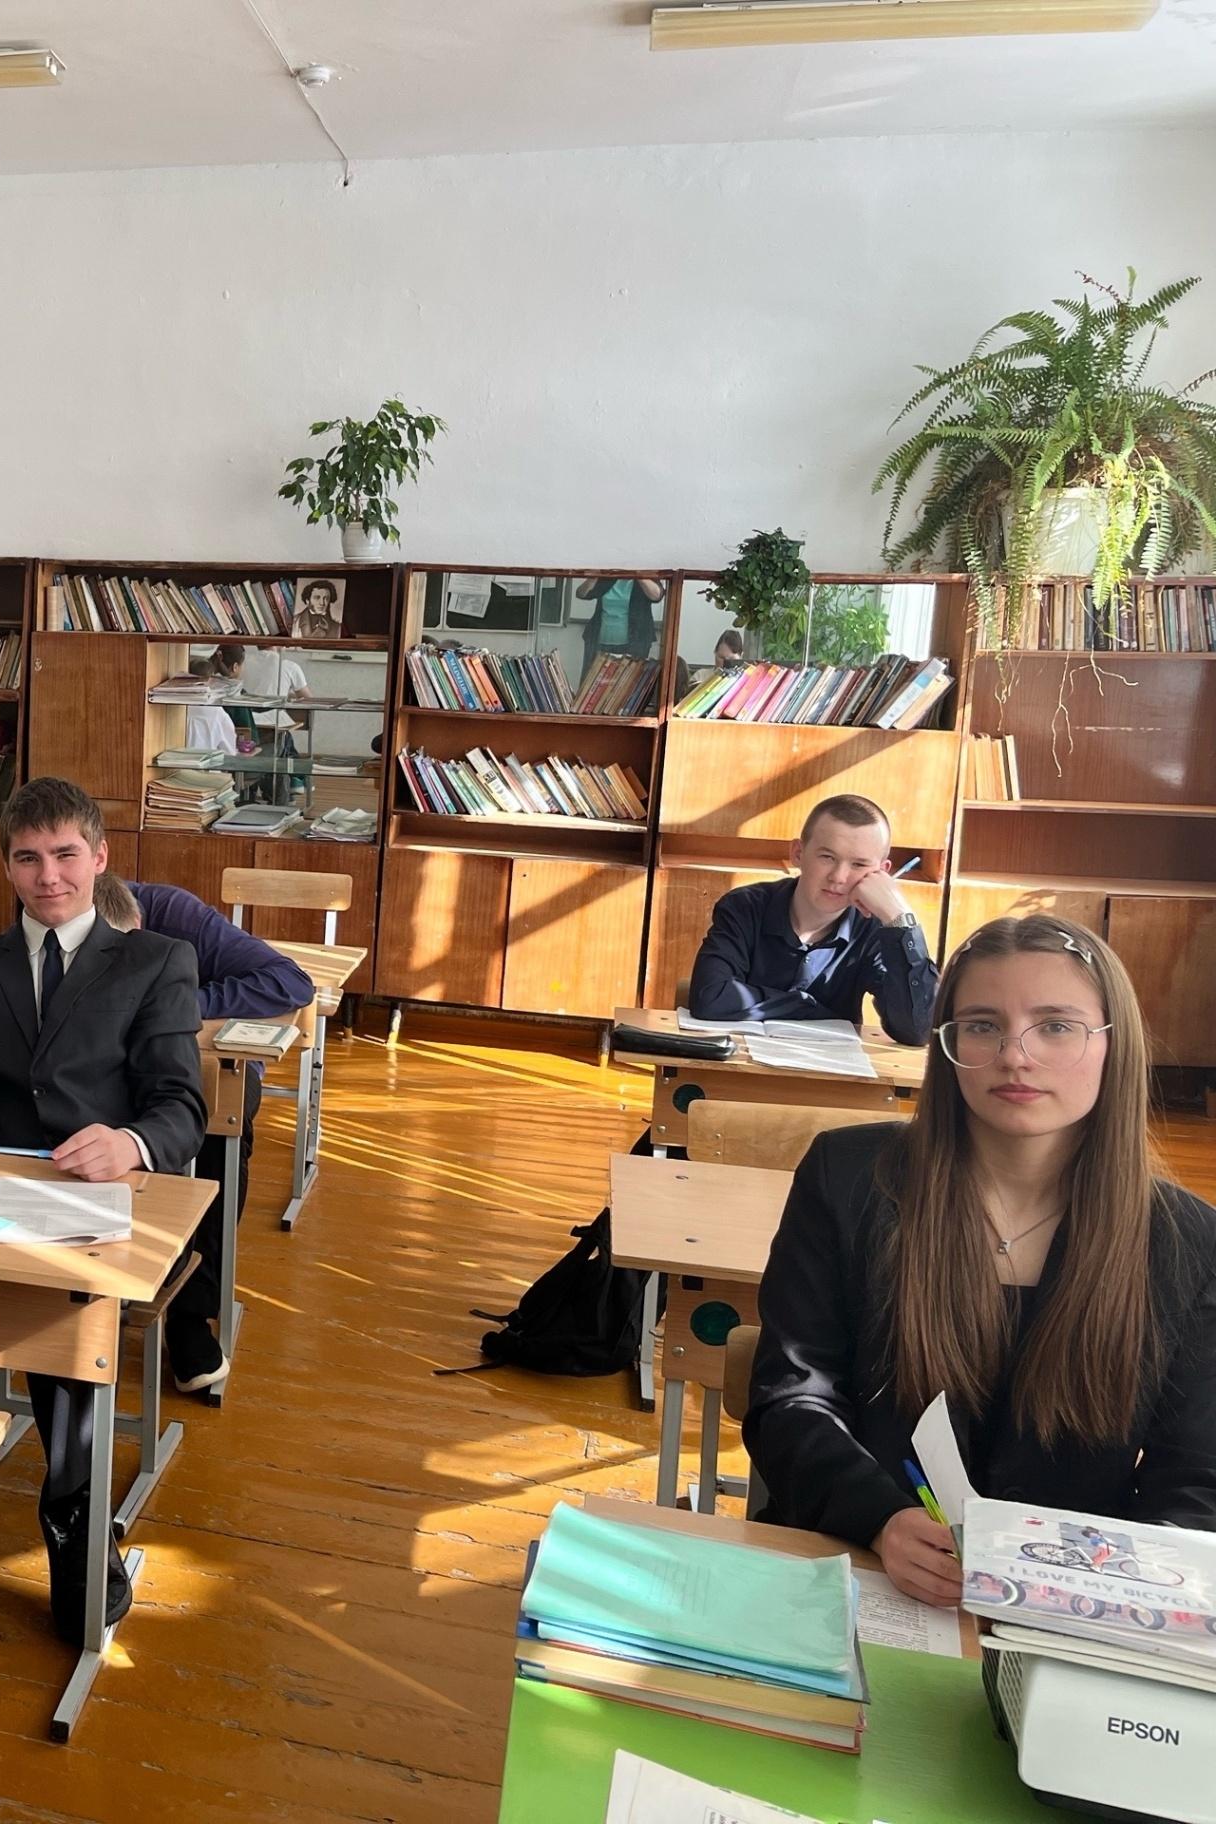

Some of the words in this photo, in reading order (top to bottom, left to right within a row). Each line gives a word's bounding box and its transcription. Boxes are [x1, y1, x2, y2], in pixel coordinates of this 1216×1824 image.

[1022, 1568, 1077, 1585] LOVE
[1083, 1579, 1114, 1592] MY
[1123, 1586, 1212, 1611] BICYCLE
[1106, 1716, 1181, 1747] EPSON
